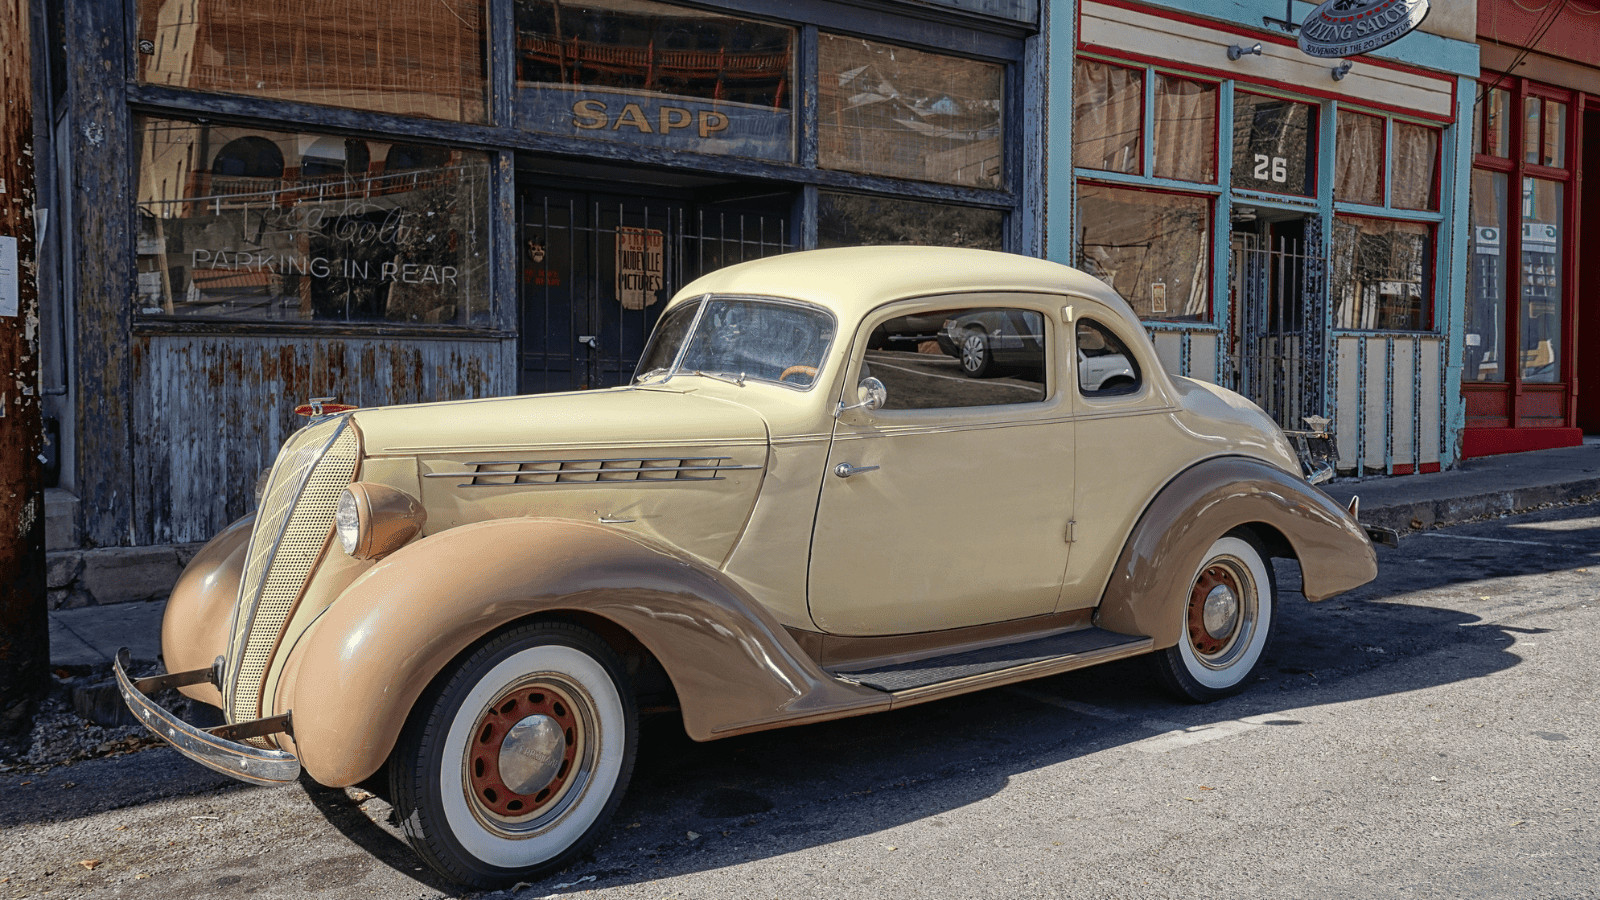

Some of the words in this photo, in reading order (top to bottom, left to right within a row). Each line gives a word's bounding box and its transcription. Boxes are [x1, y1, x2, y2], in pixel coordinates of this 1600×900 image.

[1304, 17, 1353, 41] FLYING
[1305, 44, 1339, 55] SOUVENIRS
[1350, 44, 1362, 53] THE
[1381, 19, 1414, 42] CENTURY
[572, 99, 729, 138] SAPP
[1254, 153, 1287, 183] 26
[192, 249, 330, 278] PARKING
[344, 258, 368, 281] IN
[381, 262, 458, 286] REAR
[618, 249, 661, 272] AUDEVLLE
